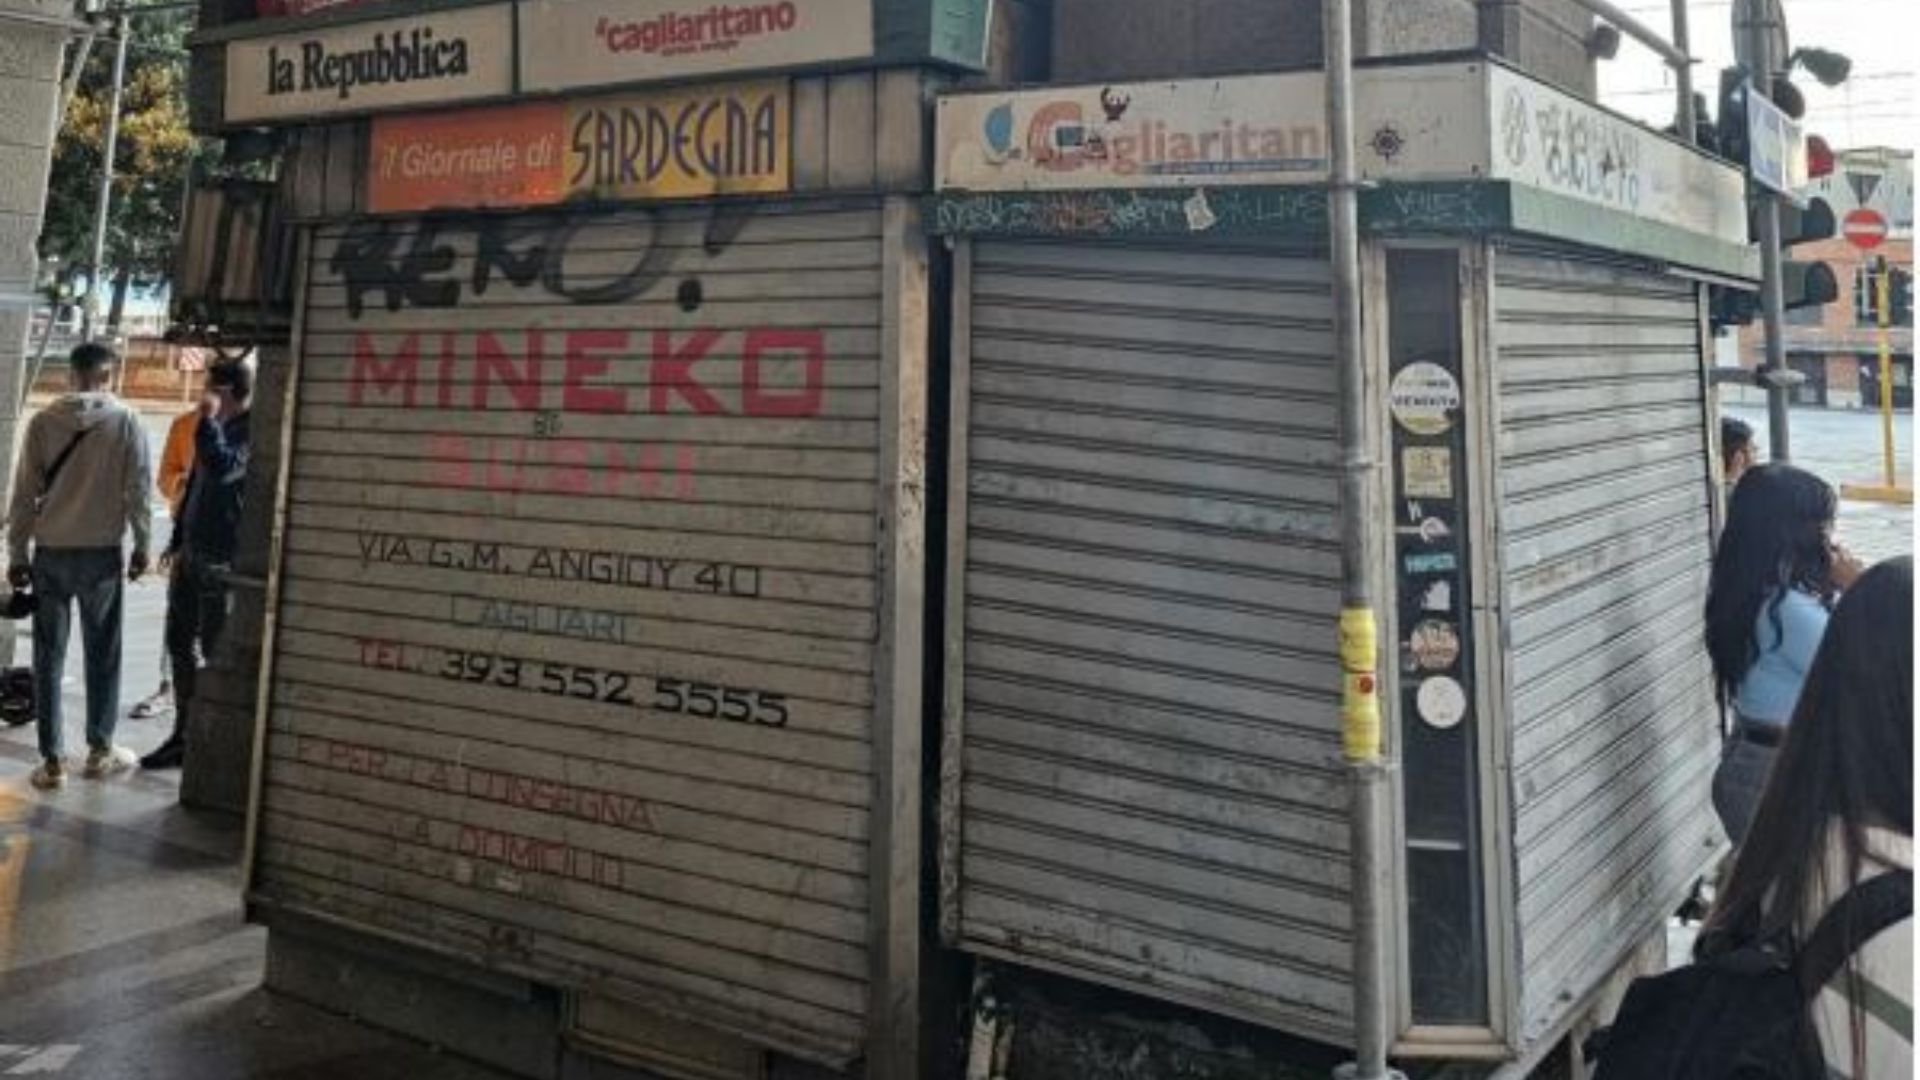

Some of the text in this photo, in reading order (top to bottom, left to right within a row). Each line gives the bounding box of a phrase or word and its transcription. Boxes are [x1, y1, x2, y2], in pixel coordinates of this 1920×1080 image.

[267, 26, 468, 98] la Repubblica
[380, 94, 777, 187] il Giornale di SARDEGNA
[349, 326, 826, 417] MINEKO
[356, 528, 762, 598] VIA G.M. ANGIOY 40
[356, 636, 788, 729] TEL. 393 552 5555
